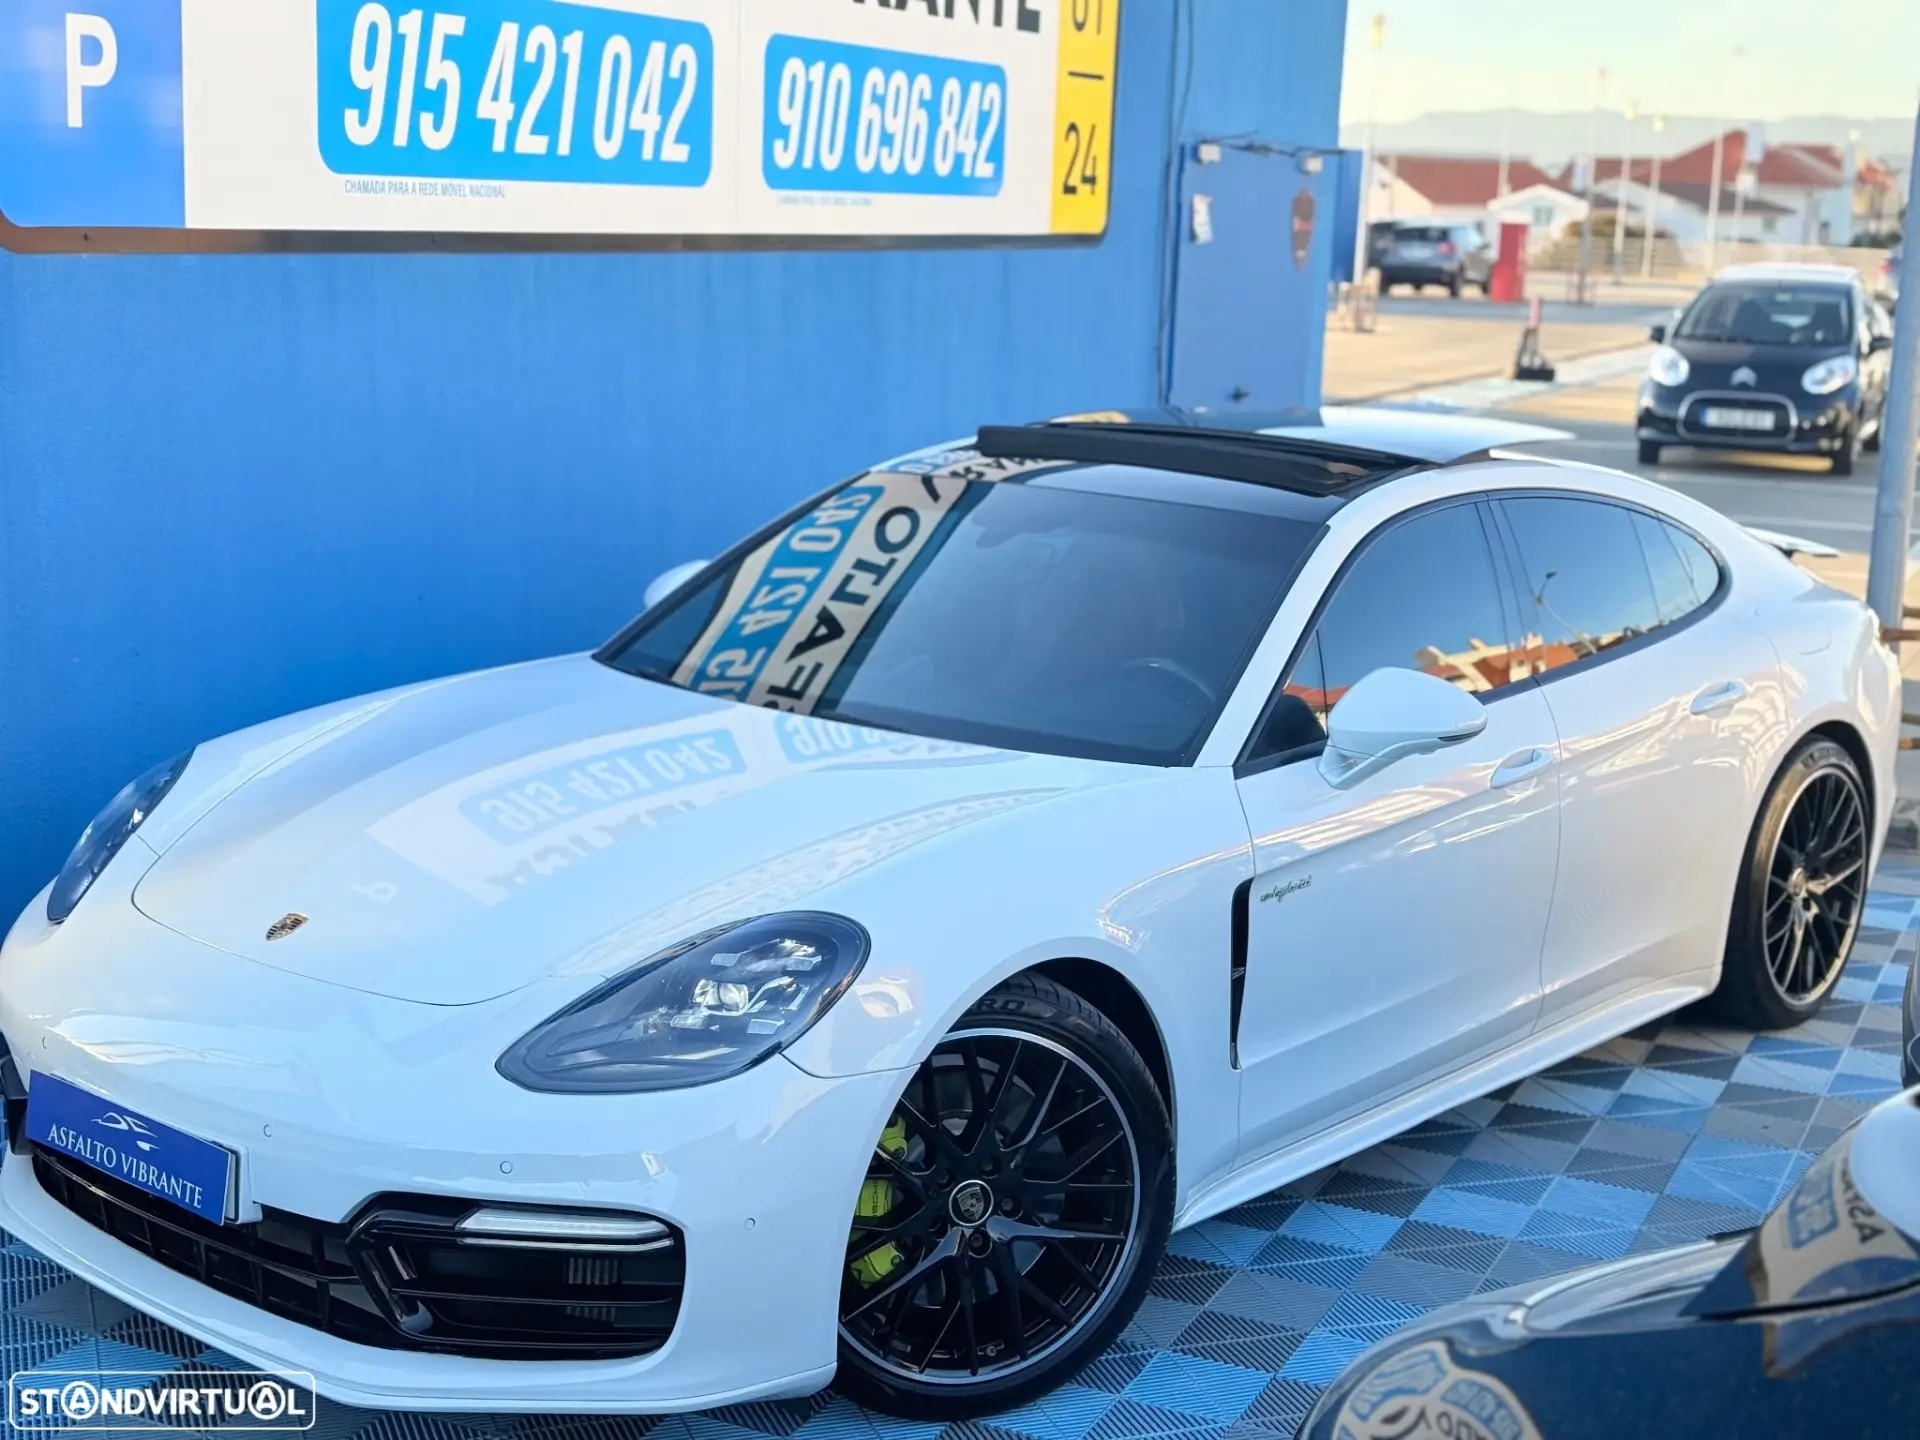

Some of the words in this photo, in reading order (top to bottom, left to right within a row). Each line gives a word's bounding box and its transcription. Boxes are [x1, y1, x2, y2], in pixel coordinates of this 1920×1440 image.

[64, 13, 118, 129] P
[344, 2, 466, 151] 915
[476, 21, 584, 157] 421
[593, 34, 698, 163] 042
[773, 57, 851, 173] 910
[855, 66, 933, 176] 696
[933, 76, 1002, 179] 842
[344, 179, 386, 195] CHAMADA
[387, 180, 410, 196] PARA
[410, 182, 417, 196] A
[418, 182, 439, 197] REDE
[469, 183, 506, 199] NACIONAL
[1062, 121, 1098, 196] 24
[47, 1123, 117, 1169] ASFALTO
[120, 1151, 203, 1209] VIBRANTE
